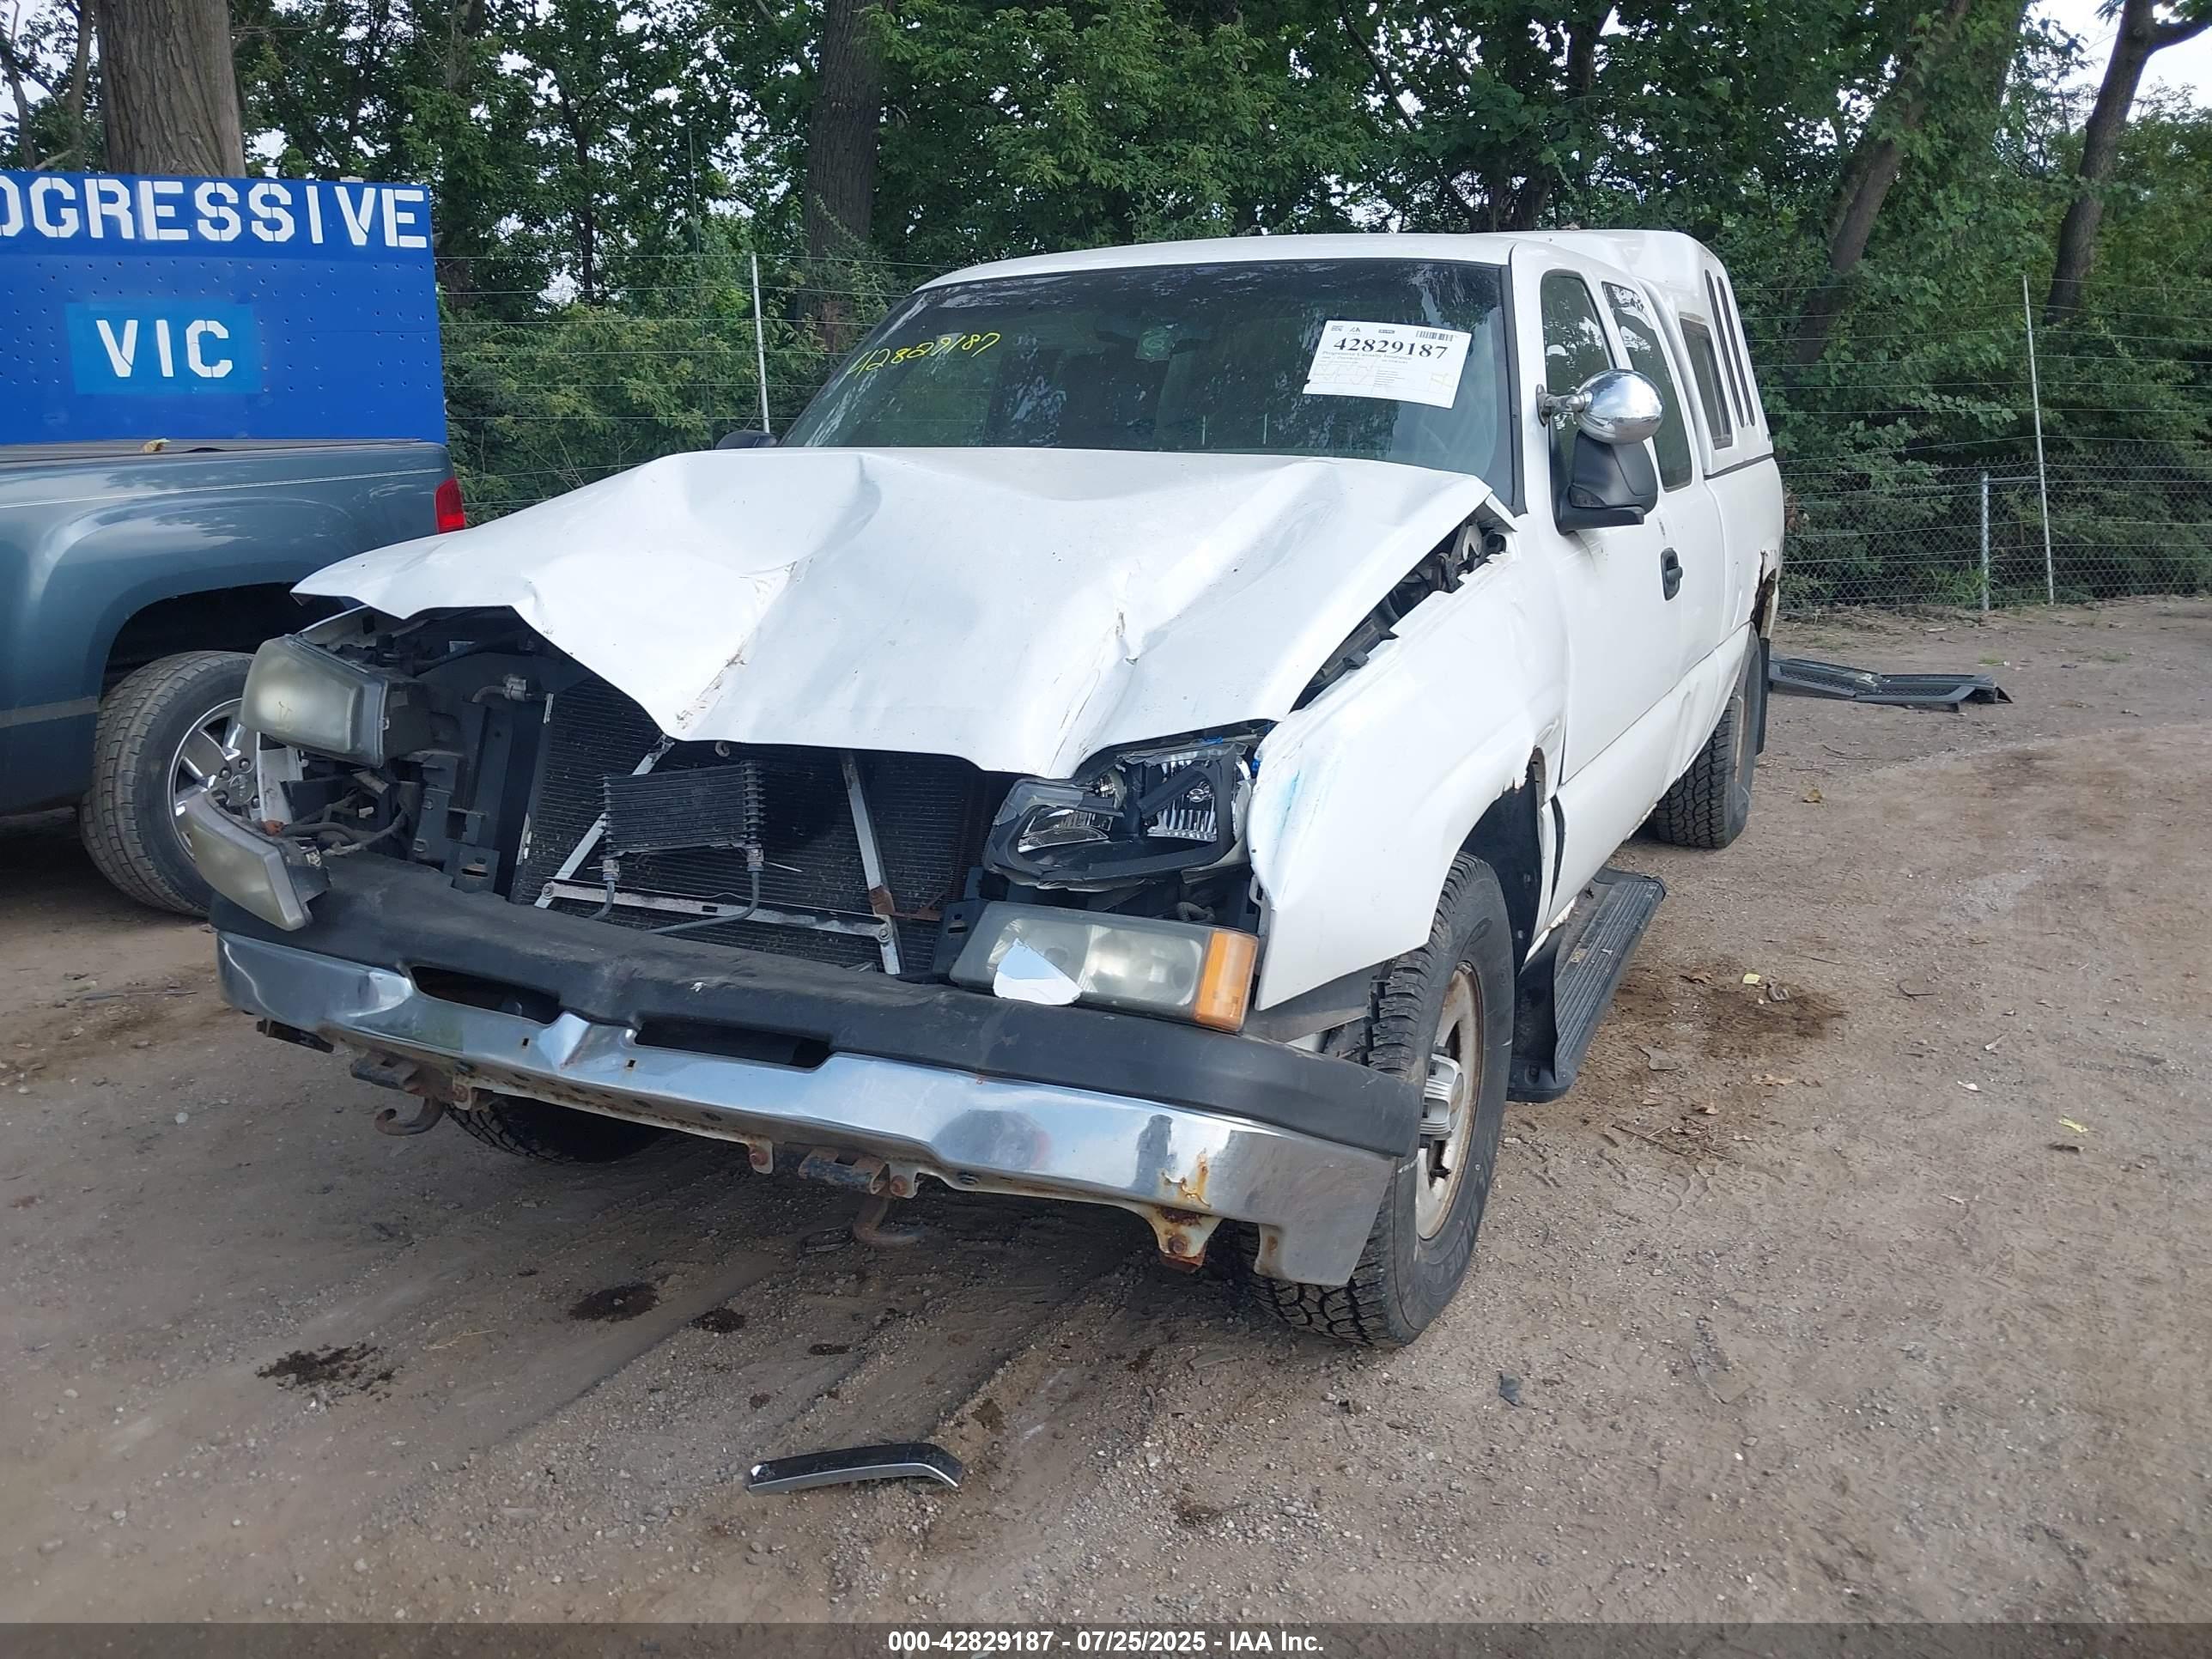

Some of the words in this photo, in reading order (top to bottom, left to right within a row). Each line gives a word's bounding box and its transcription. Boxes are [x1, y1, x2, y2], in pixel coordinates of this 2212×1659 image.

[96, 319, 234, 378] VIC
[846, 331, 1001, 380] 42829187
[1333, 337, 1449, 359] 42829187
